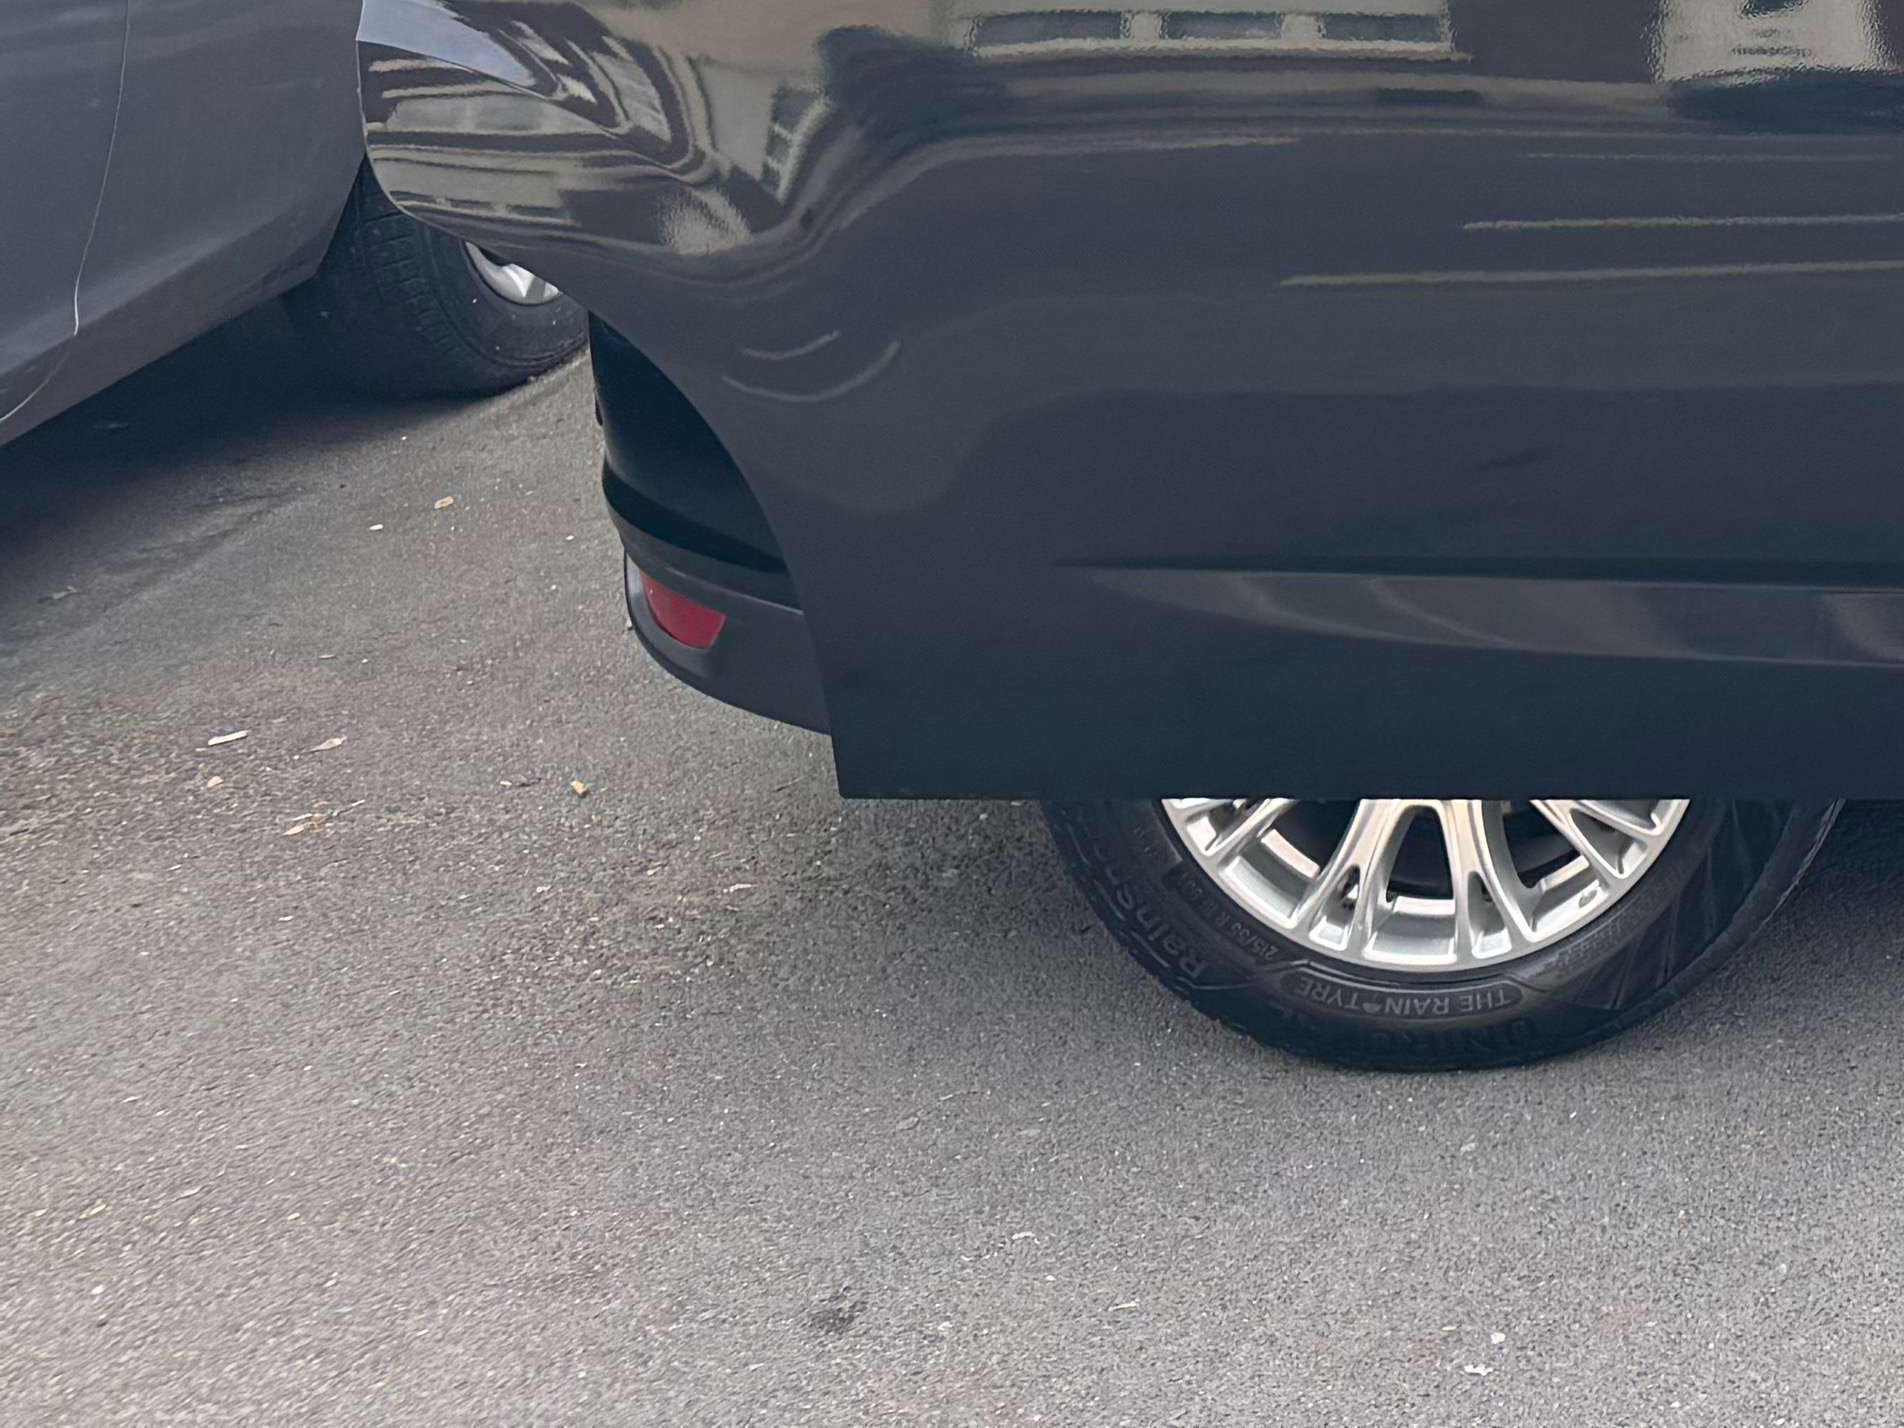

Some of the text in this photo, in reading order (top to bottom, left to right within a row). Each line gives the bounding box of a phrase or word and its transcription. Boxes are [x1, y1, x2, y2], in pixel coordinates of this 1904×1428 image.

[1302, 979, 1507, 1016] THE RAIN TYRE
